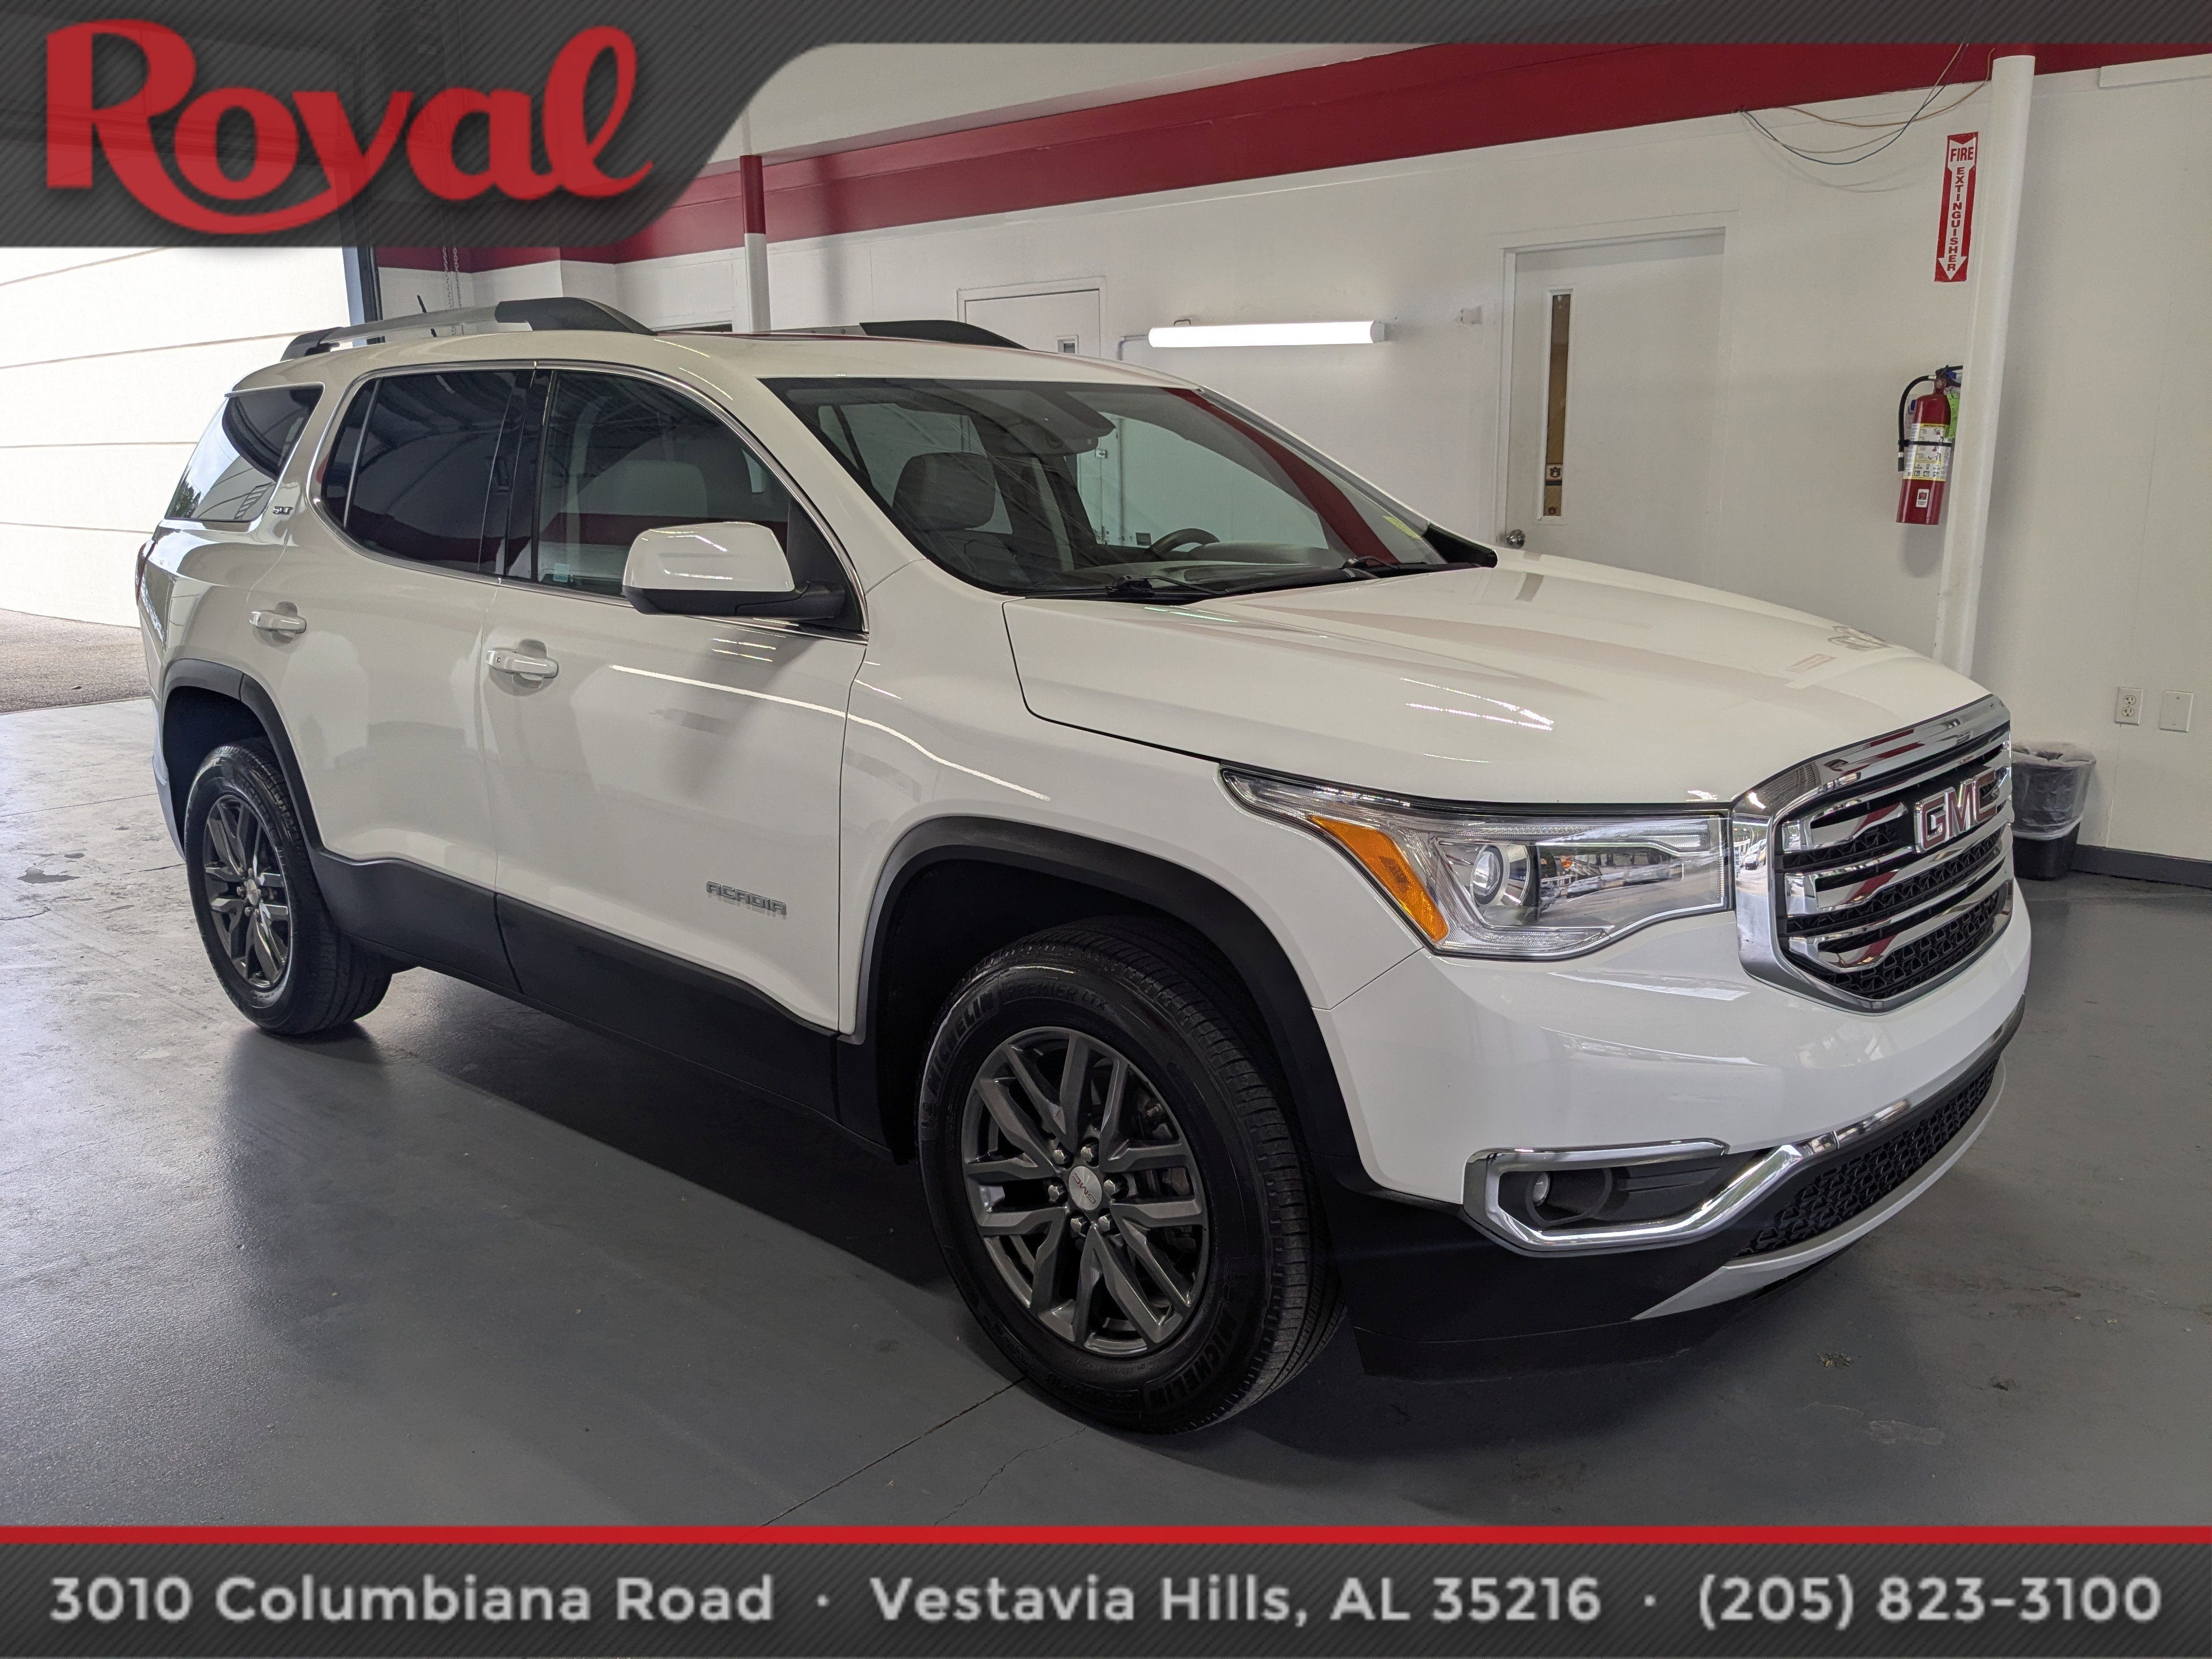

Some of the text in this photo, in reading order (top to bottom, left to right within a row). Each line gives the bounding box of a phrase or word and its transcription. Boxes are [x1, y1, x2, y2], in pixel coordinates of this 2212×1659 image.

[1950, 146, 1974, 162] FIRE
[1946, 166, 1966, 272] EXTINGUISHER
[273, 506, 294, 515] SLT
[1914, 768, 1997, 854] GMC
[706, 881, 787, 916] ACADIA
[926, 990, 995, 1099] MICHELIN
[1072, 1172, 1096, 1204] GMC
